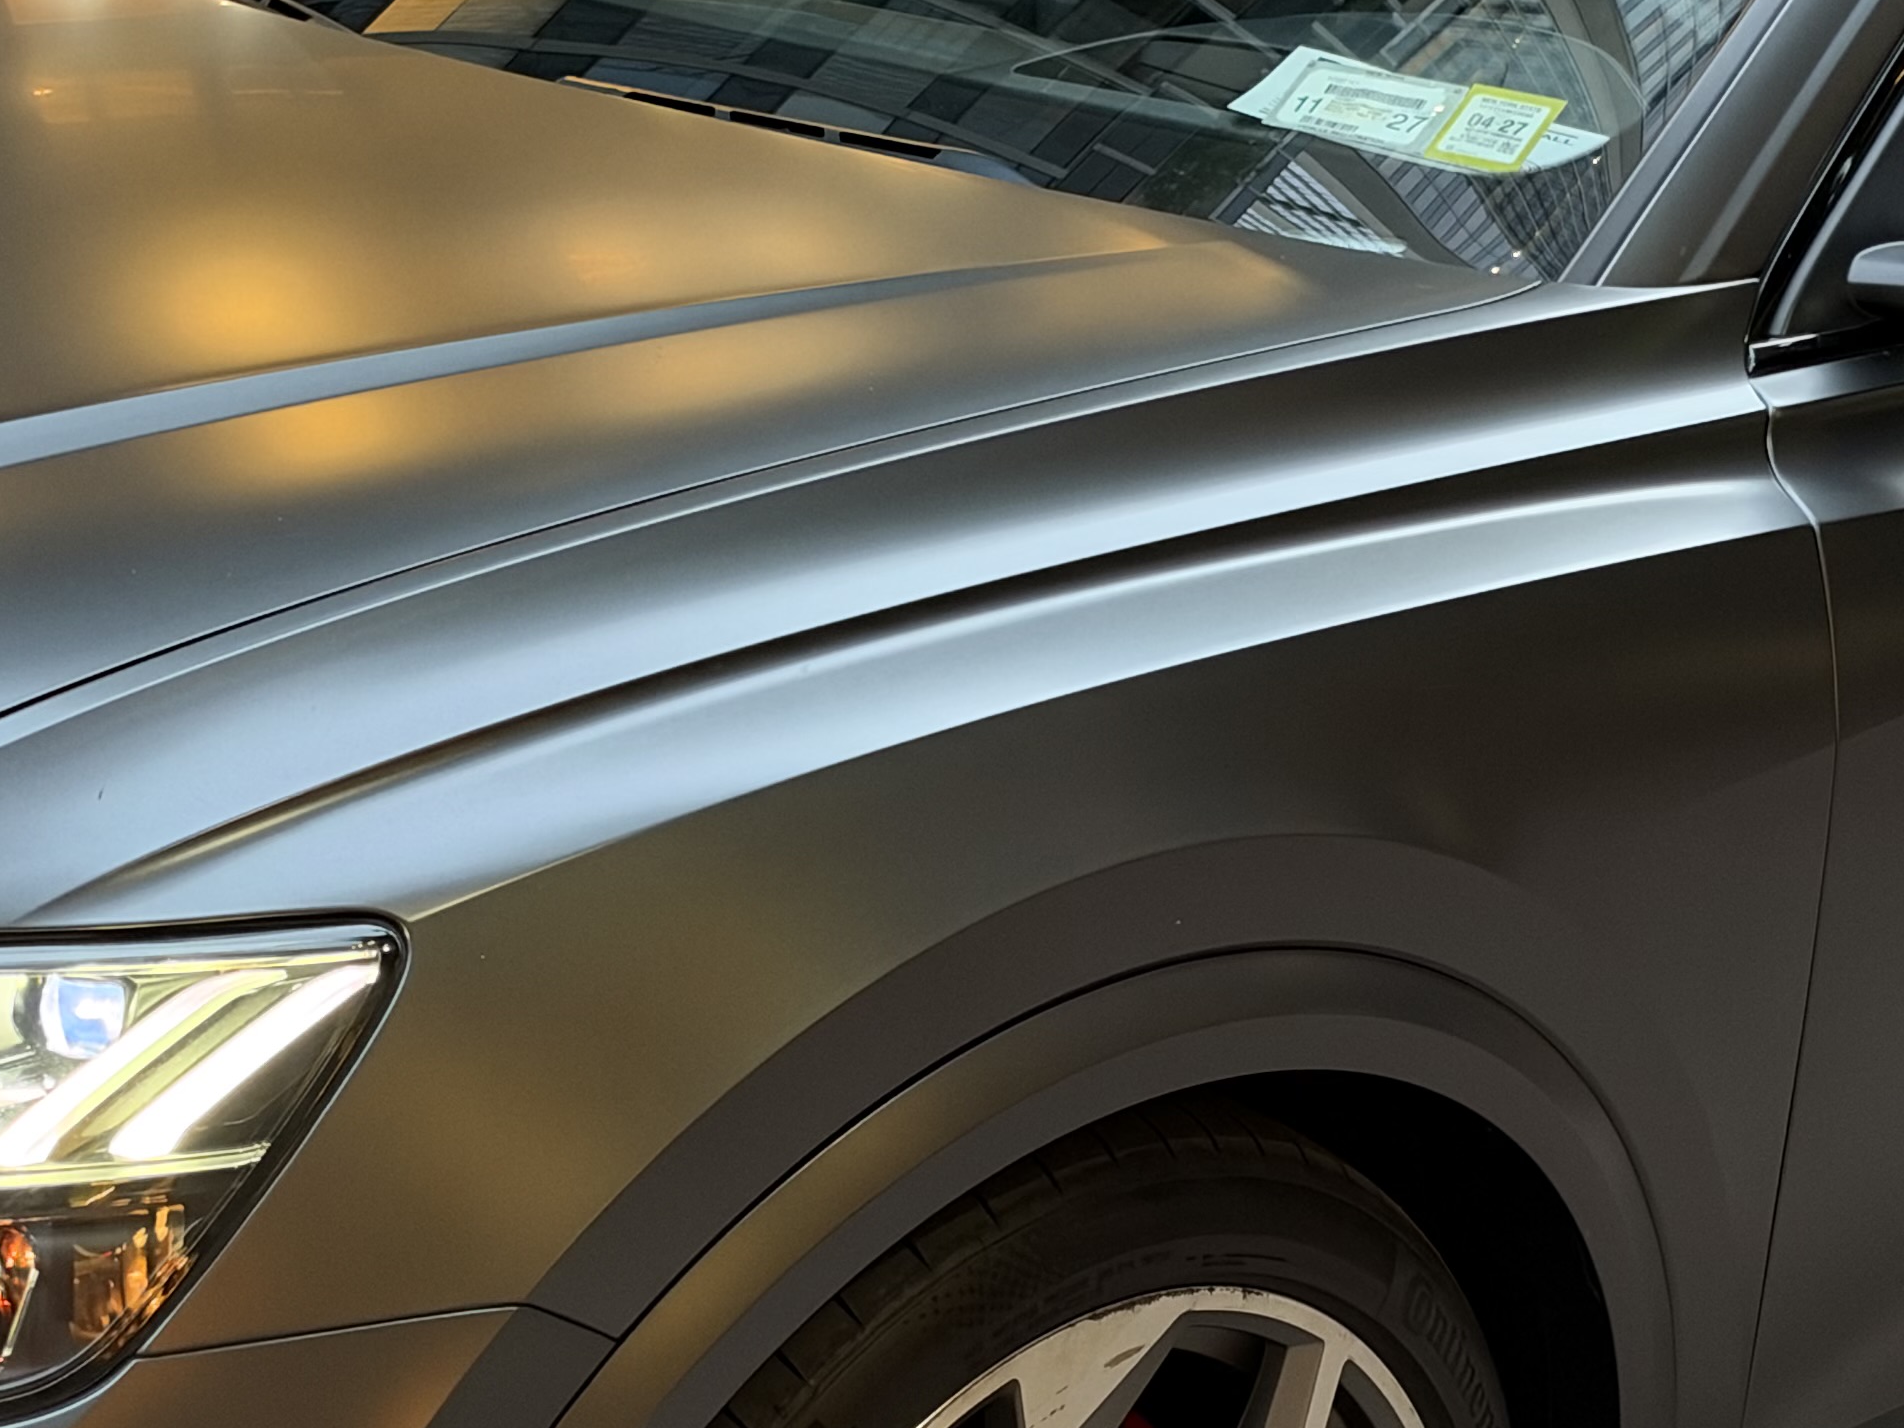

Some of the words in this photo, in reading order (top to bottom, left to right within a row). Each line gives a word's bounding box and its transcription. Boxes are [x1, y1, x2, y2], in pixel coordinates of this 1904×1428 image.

[1294, 95, 1323, 114] 11
[1385, 113, 1429, 134] 27
[1467, 112, 1495, 129] 04
[1498, 118, 1529, 136] 27
